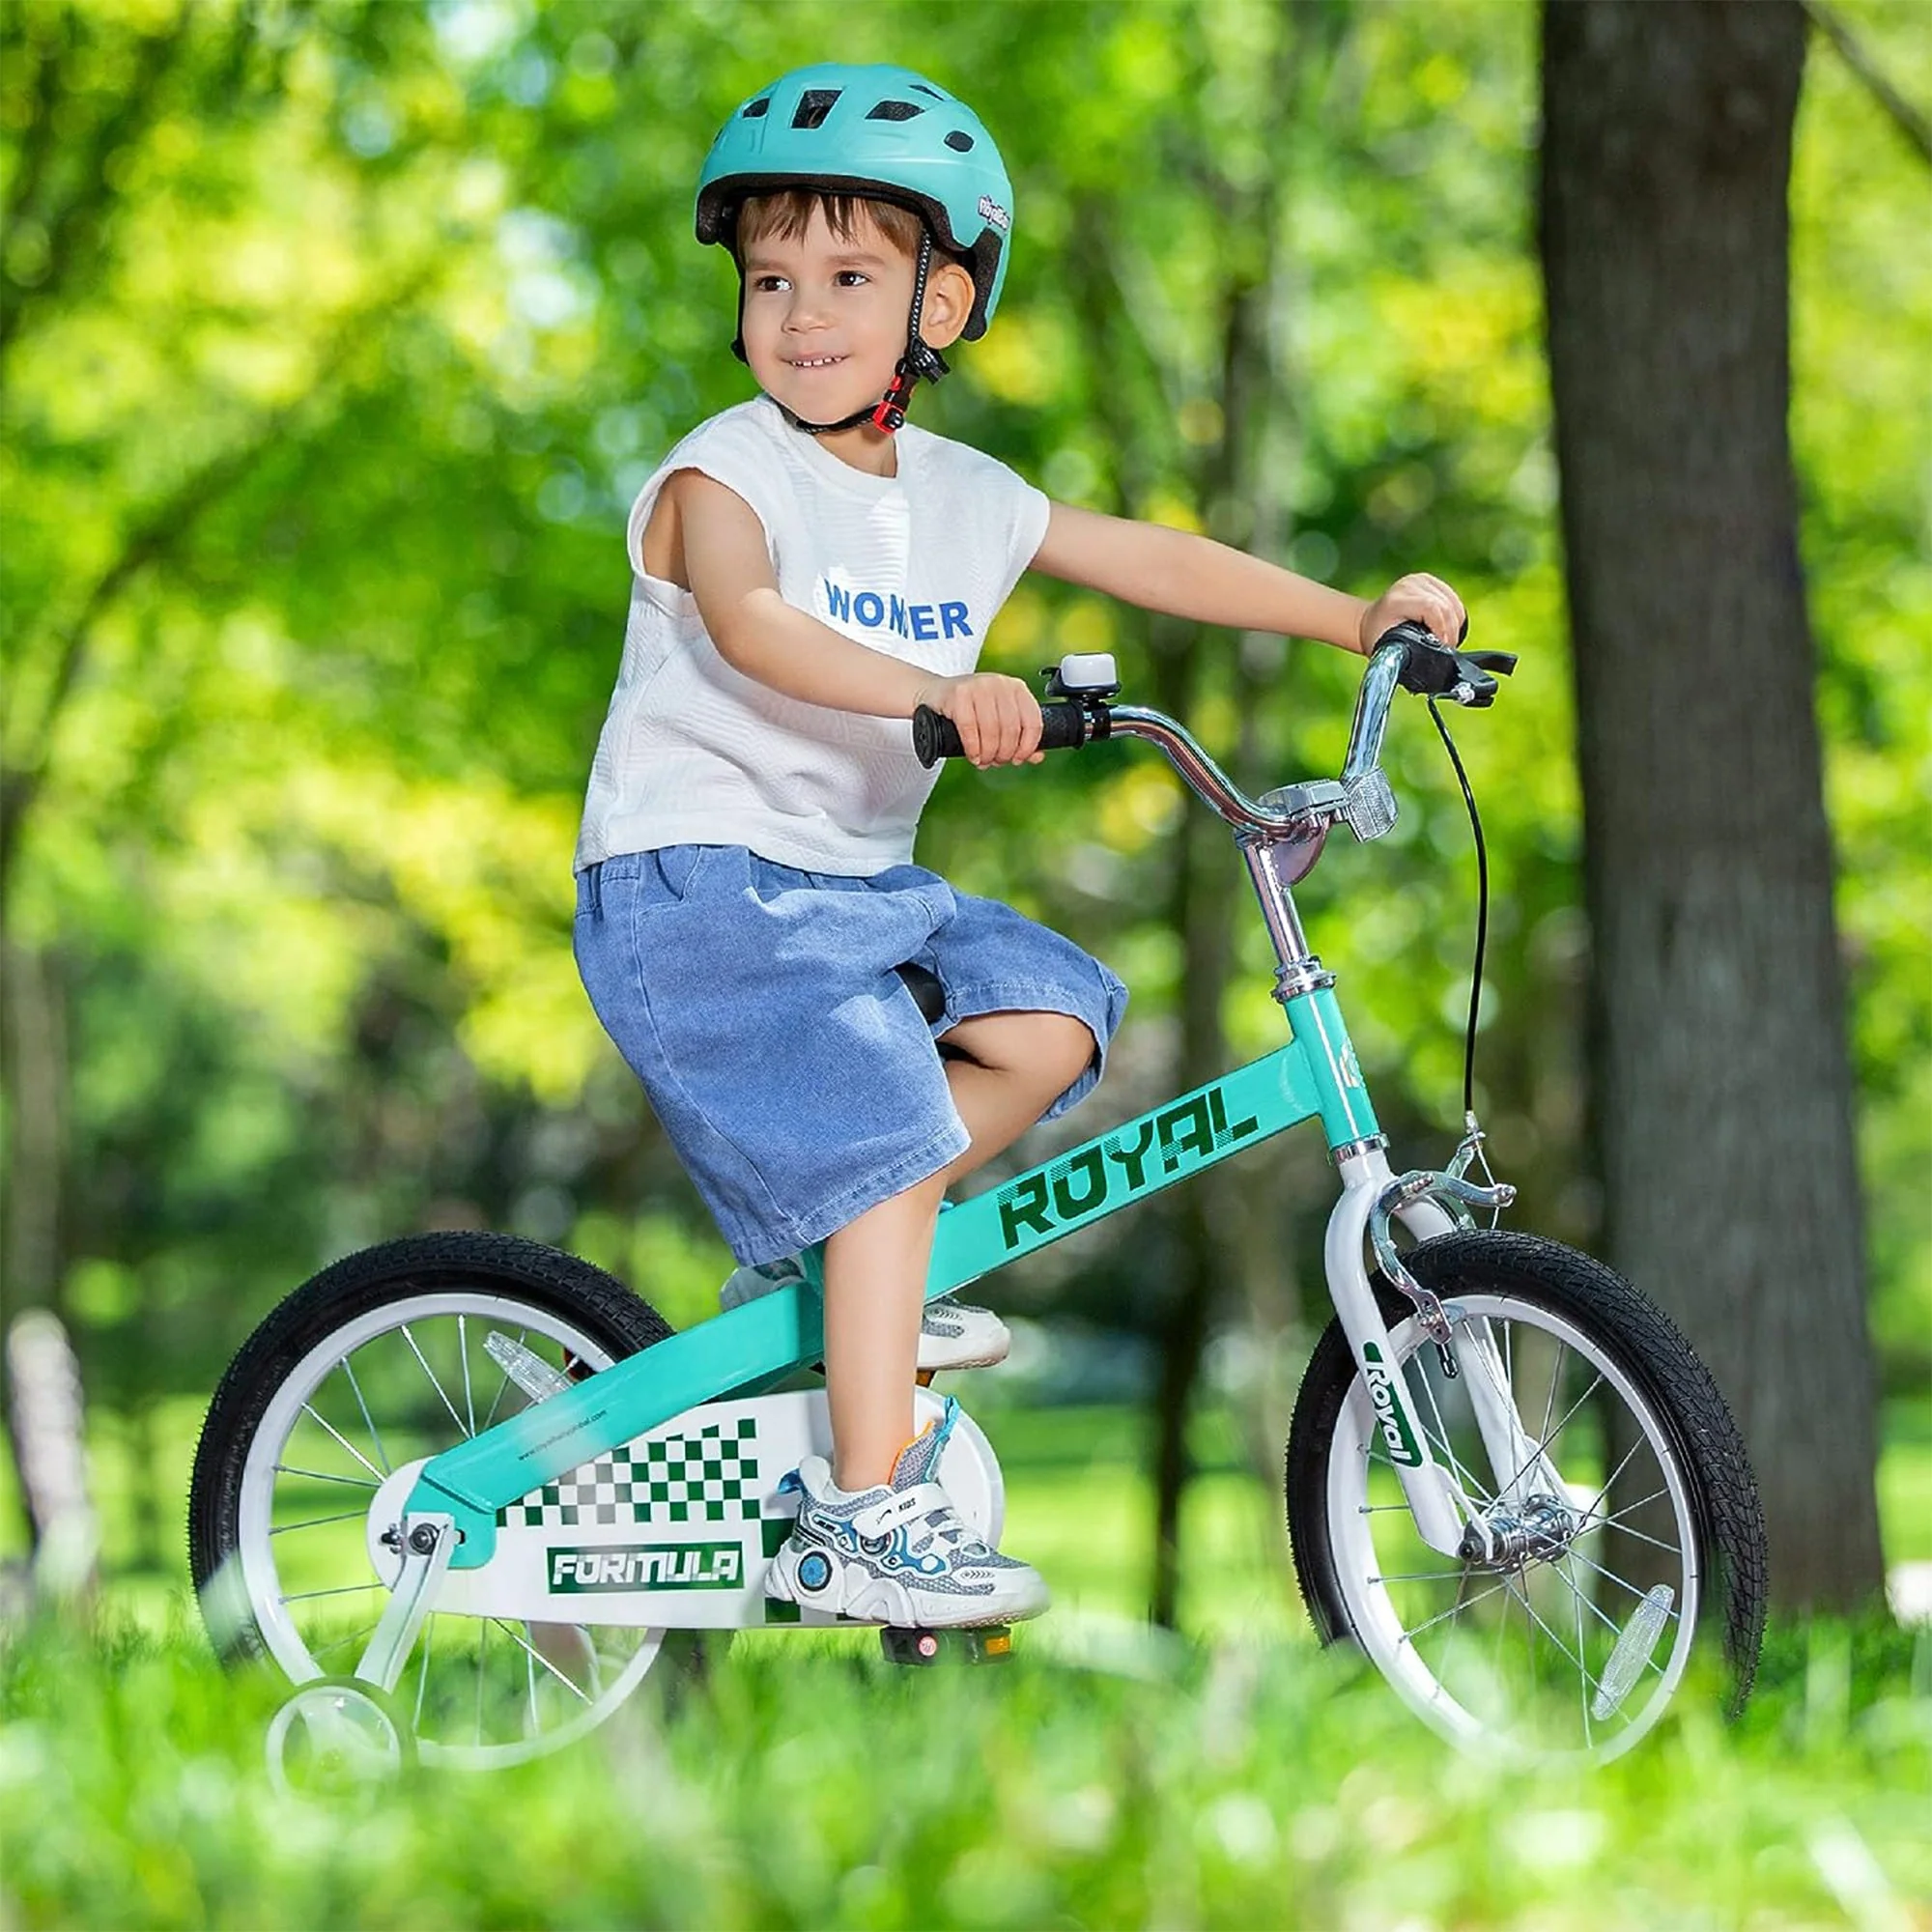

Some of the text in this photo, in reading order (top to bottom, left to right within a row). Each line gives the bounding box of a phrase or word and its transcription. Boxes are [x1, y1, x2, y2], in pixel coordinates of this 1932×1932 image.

[824, 579, 974, 641] WONER
[997, 1087, 1259, 1251] ROYAL
[1364, 1361, 1413, 1461] Royal
[553, 1549, 740, 1585] FORMULA
